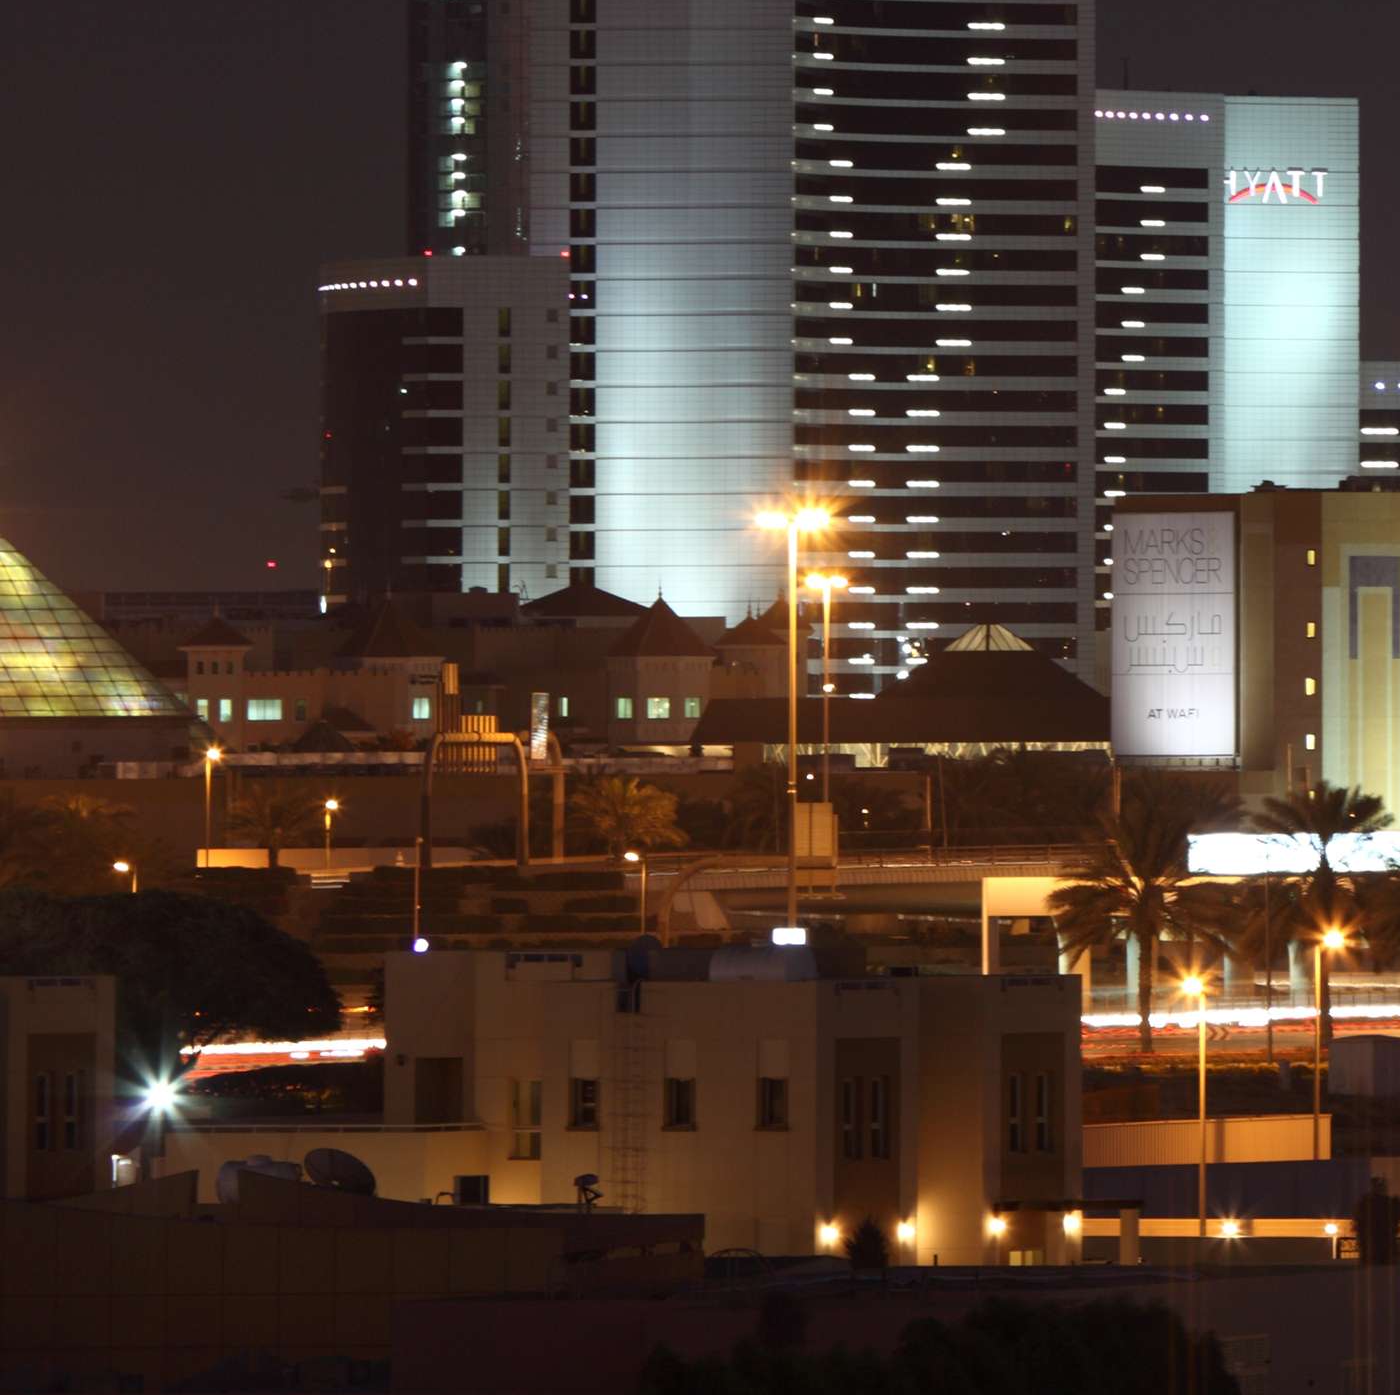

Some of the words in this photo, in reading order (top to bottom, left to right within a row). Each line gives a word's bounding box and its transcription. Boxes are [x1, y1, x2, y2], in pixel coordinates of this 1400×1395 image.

[1123, 527, 1206, 556] MARKS
[1123, 557, 1222, 585] SPENCER
[1147, 708, 1164, 719] AT
